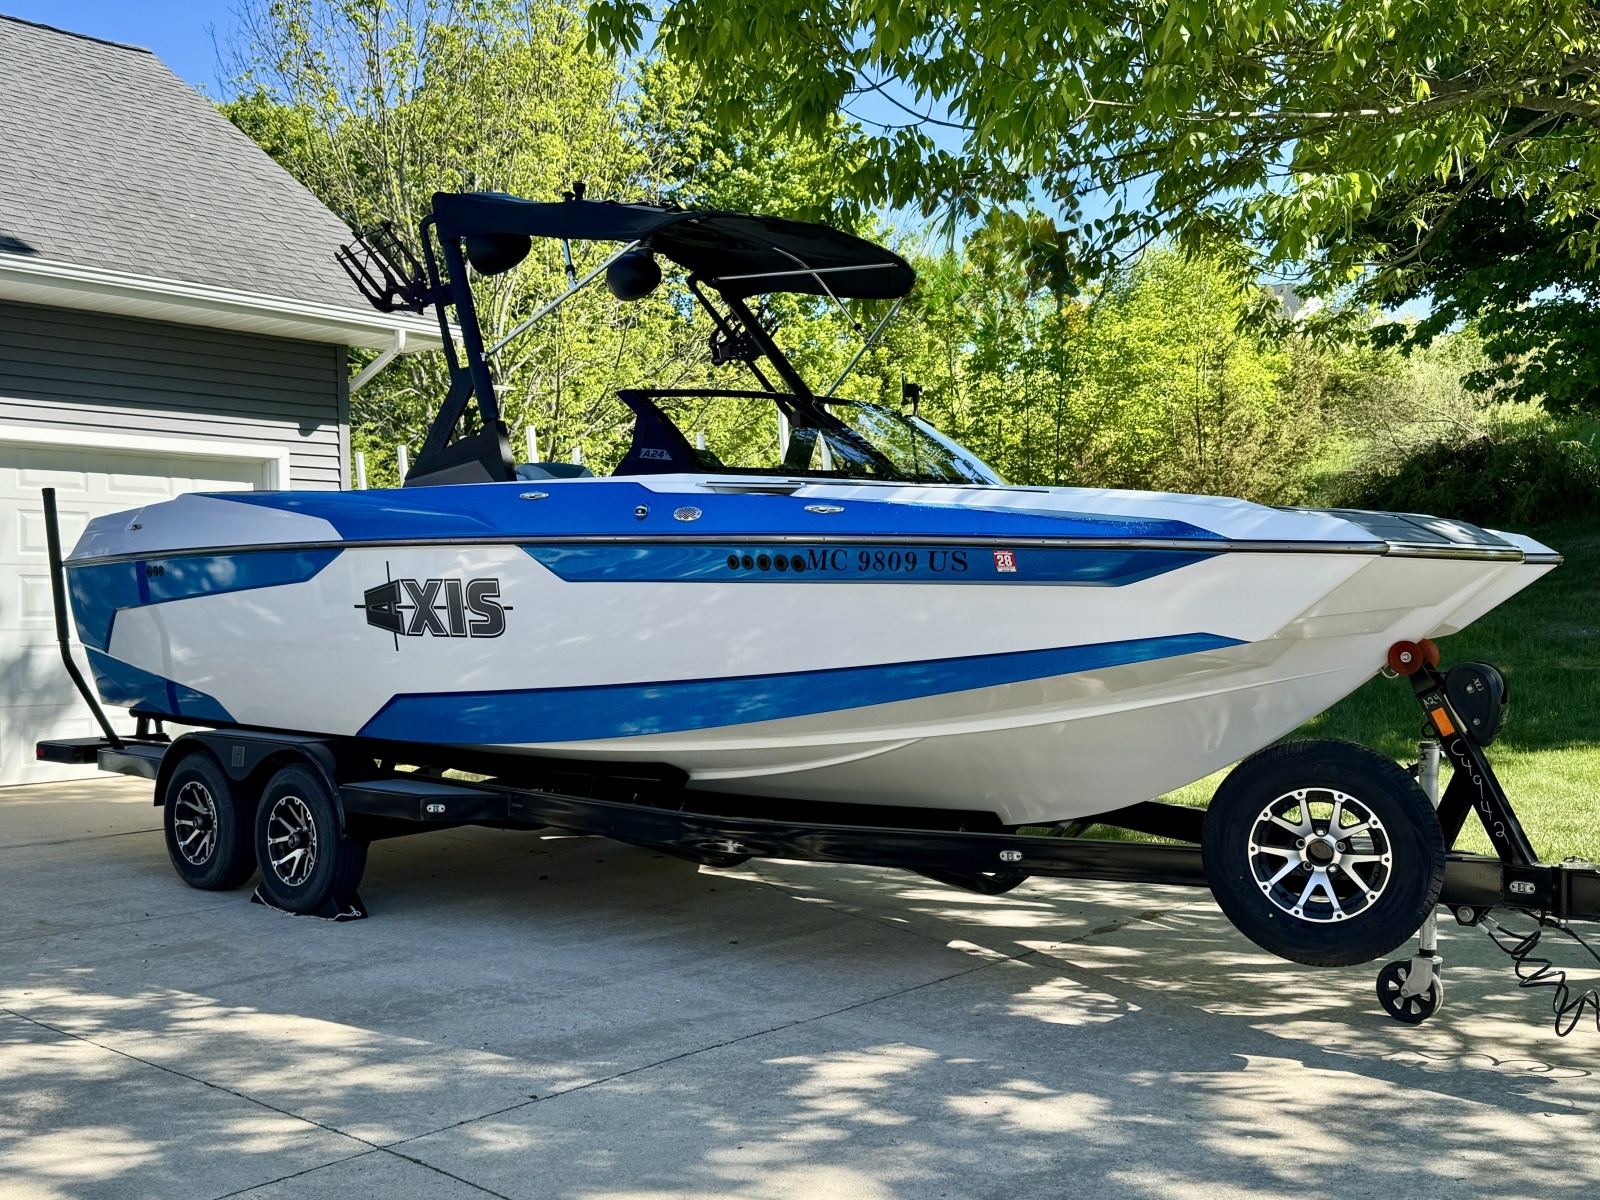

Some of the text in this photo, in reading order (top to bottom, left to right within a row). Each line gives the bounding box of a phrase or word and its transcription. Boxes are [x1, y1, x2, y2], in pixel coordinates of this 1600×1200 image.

[643, 449, 666, 459] A24
[806, 549, 969, 572] MC 9809 US
[996, 554, 1013, 567] 28
[364, 577, 507, 638] AXIS
[1422, 693, 1443, 709] A24
